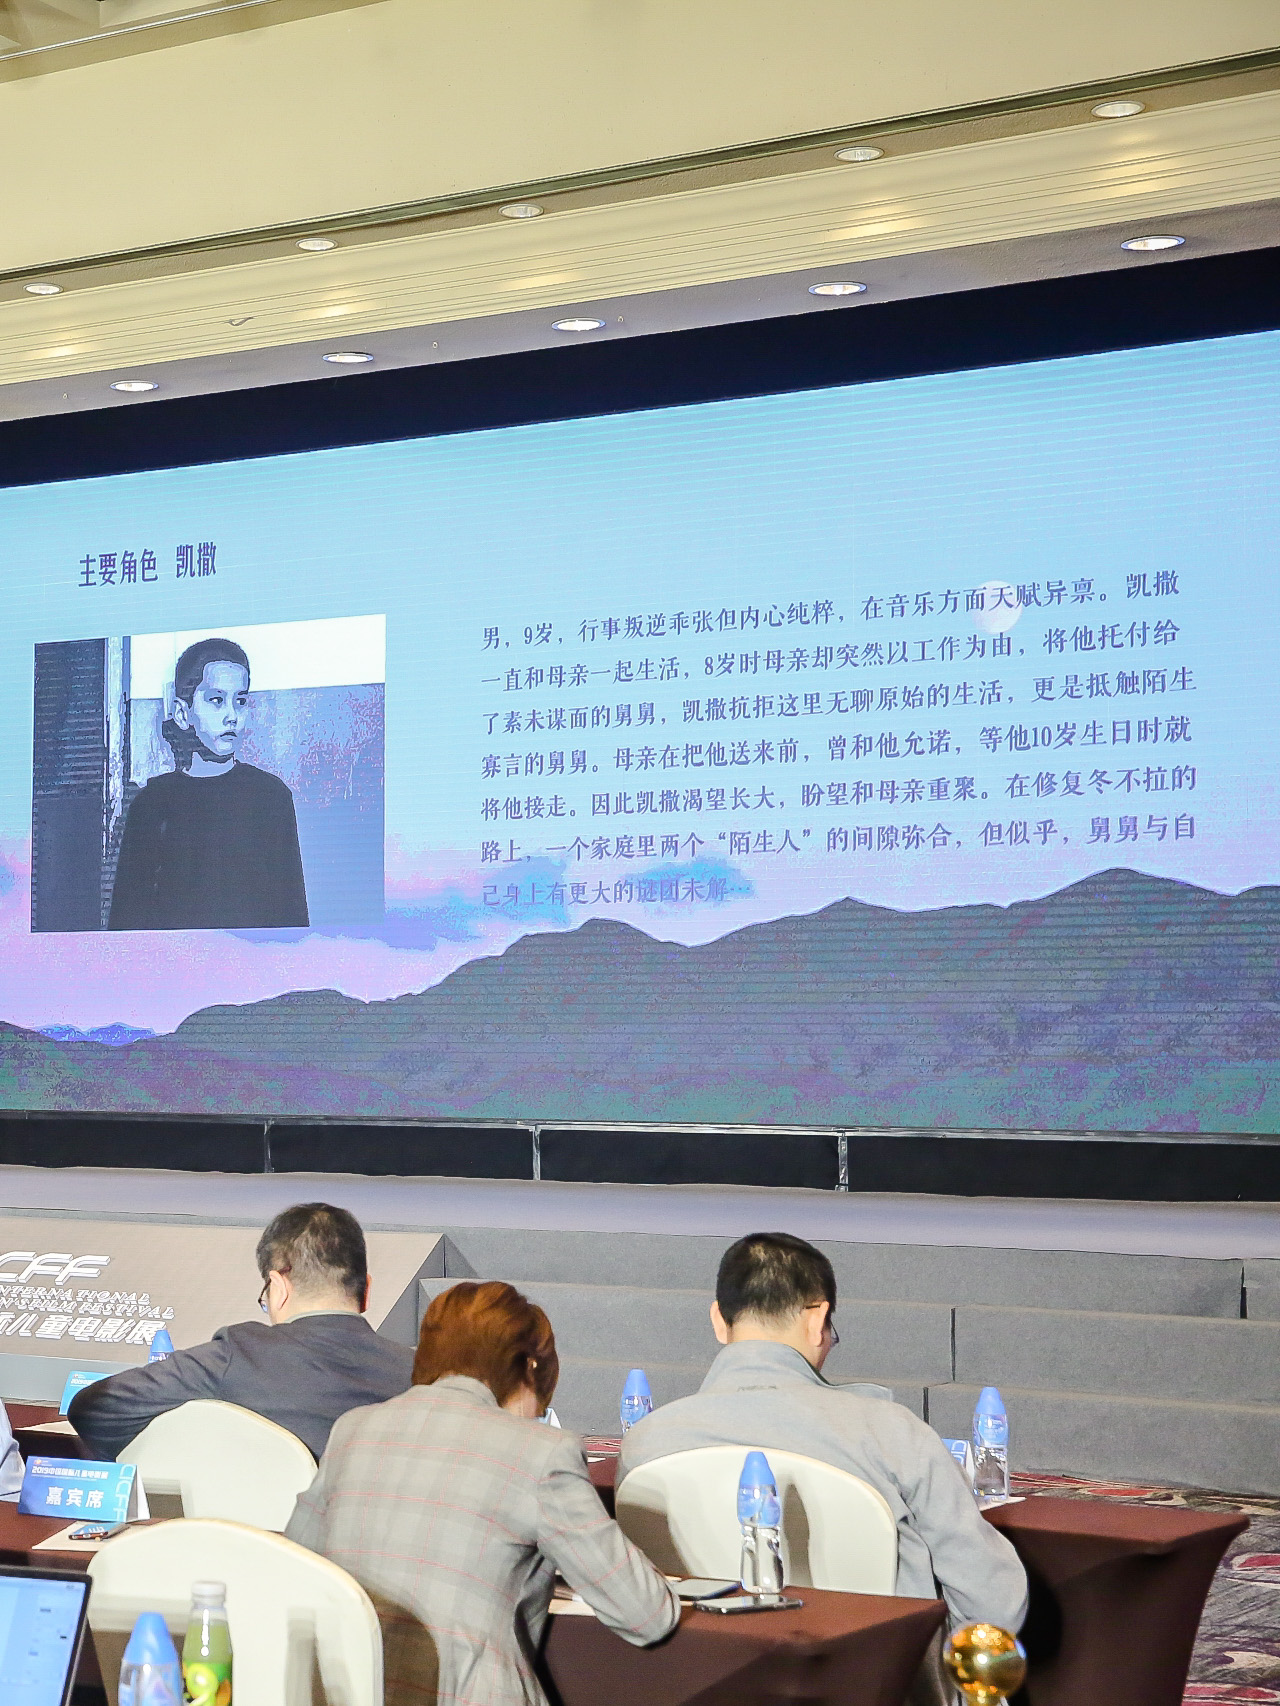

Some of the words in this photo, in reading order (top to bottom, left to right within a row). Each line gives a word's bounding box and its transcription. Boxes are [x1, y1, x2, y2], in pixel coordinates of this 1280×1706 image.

[78, 548, 158, 588] 主要角色
[175, 541, 217, 579] 凯撒
[45, 1486, 104, 1508] 嘉宾席
